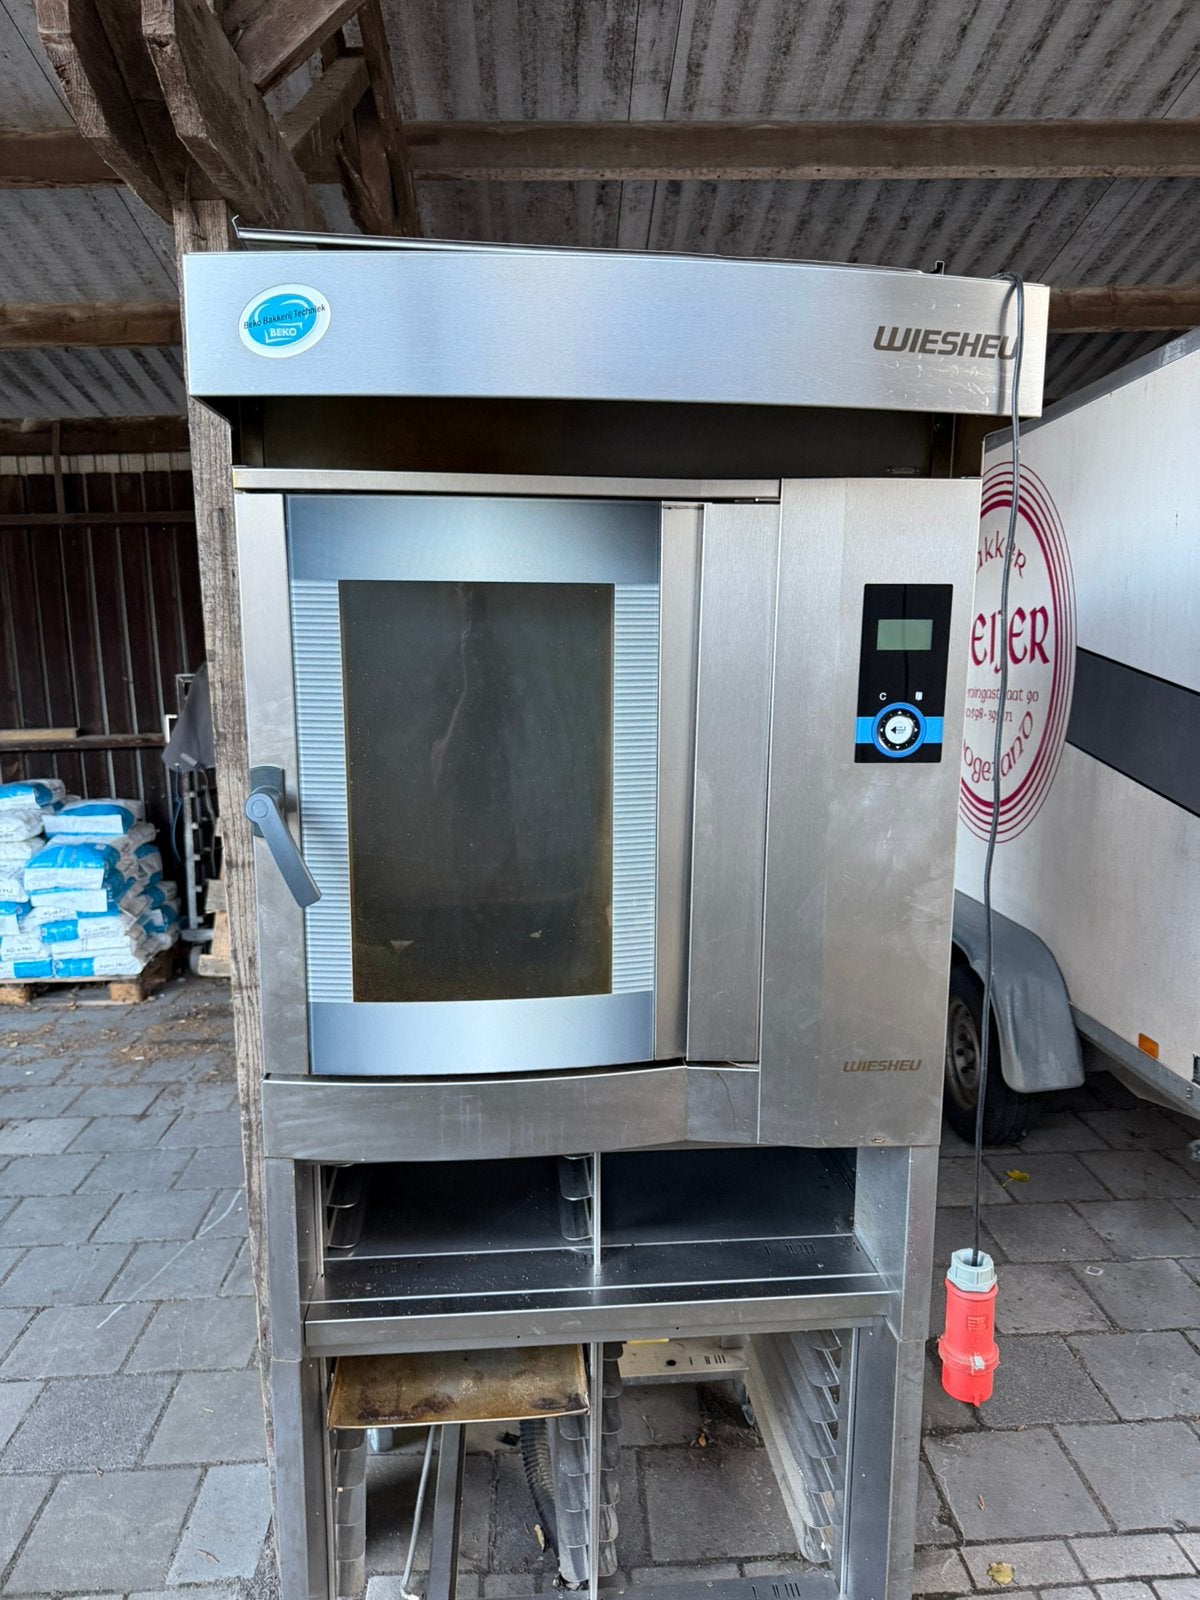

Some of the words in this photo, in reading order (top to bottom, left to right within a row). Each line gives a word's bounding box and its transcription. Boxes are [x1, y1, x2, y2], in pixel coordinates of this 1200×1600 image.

[243, 319, 261, 330] Beko
[262, 313, 293, 325] Bakkerij
[293, 304, 326, 318] Techniek
[269, 327, 298, 337] BEKO
[873, 326, 1018, 360] WIESHEU
[879, 692, 888, 701] C
[842, 1060, 922, 1073] WIESHEU
